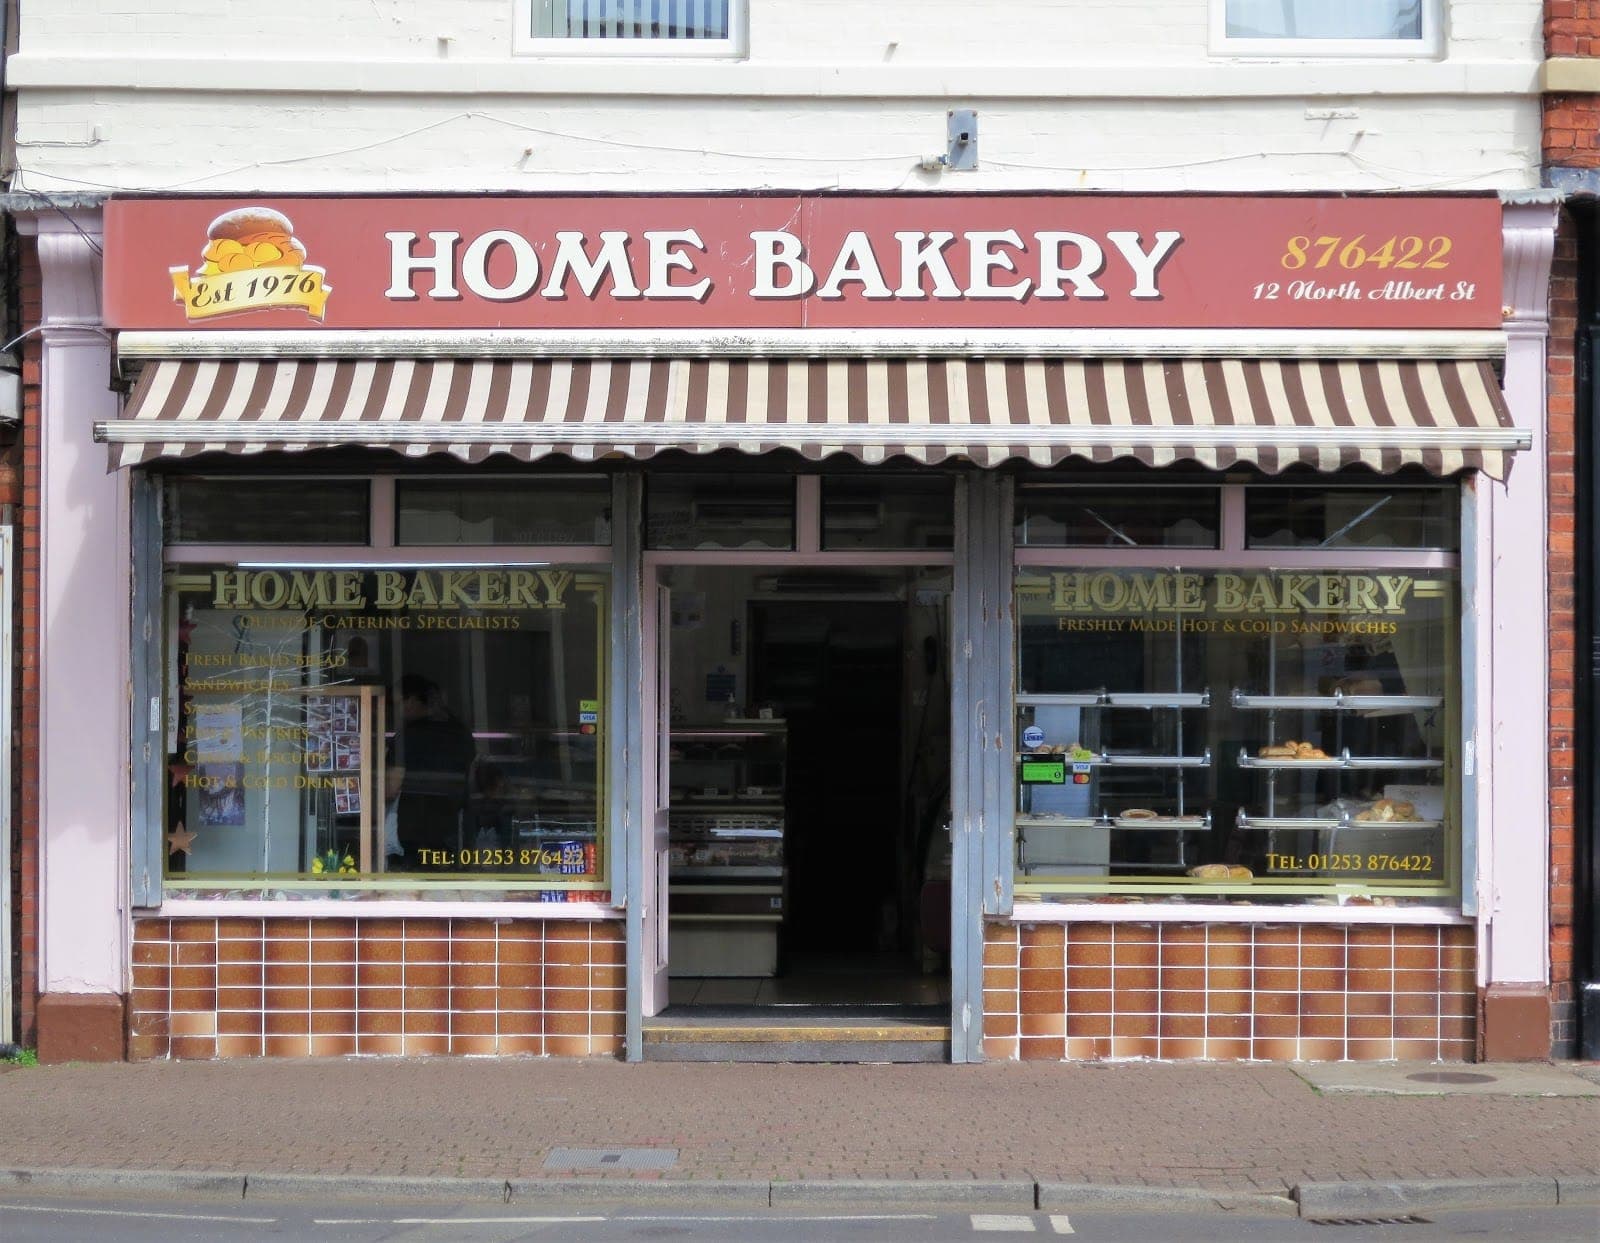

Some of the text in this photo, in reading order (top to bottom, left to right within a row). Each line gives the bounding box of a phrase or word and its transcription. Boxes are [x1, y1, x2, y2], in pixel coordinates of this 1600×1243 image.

[383, 229, 1183, 302] HOME BAKERY
[1280, 233, 1453, 270] 876422
[191, 272, 316, 308] Est 1976
[1252, 280, 1477, 301] 12 North Albert St
[212, 570, 574, 610] HOME BAKERY
[1051, 571, 1414, 615] HOME BAKERY
[323, 614, 411, 630] CATERING
[417, 614, 521, 630] SPECIALISTS
[1058, 616, 1398, 634] FRESHLY MADE HOT & COLD SANDWICHES
[418, 849, 455, 866] TEL:
[459, 849, 515, 866] 01253
[519, 849, 585, 866] 876422
[1265, 853, 1434, 872] TEL: 01253 876422
